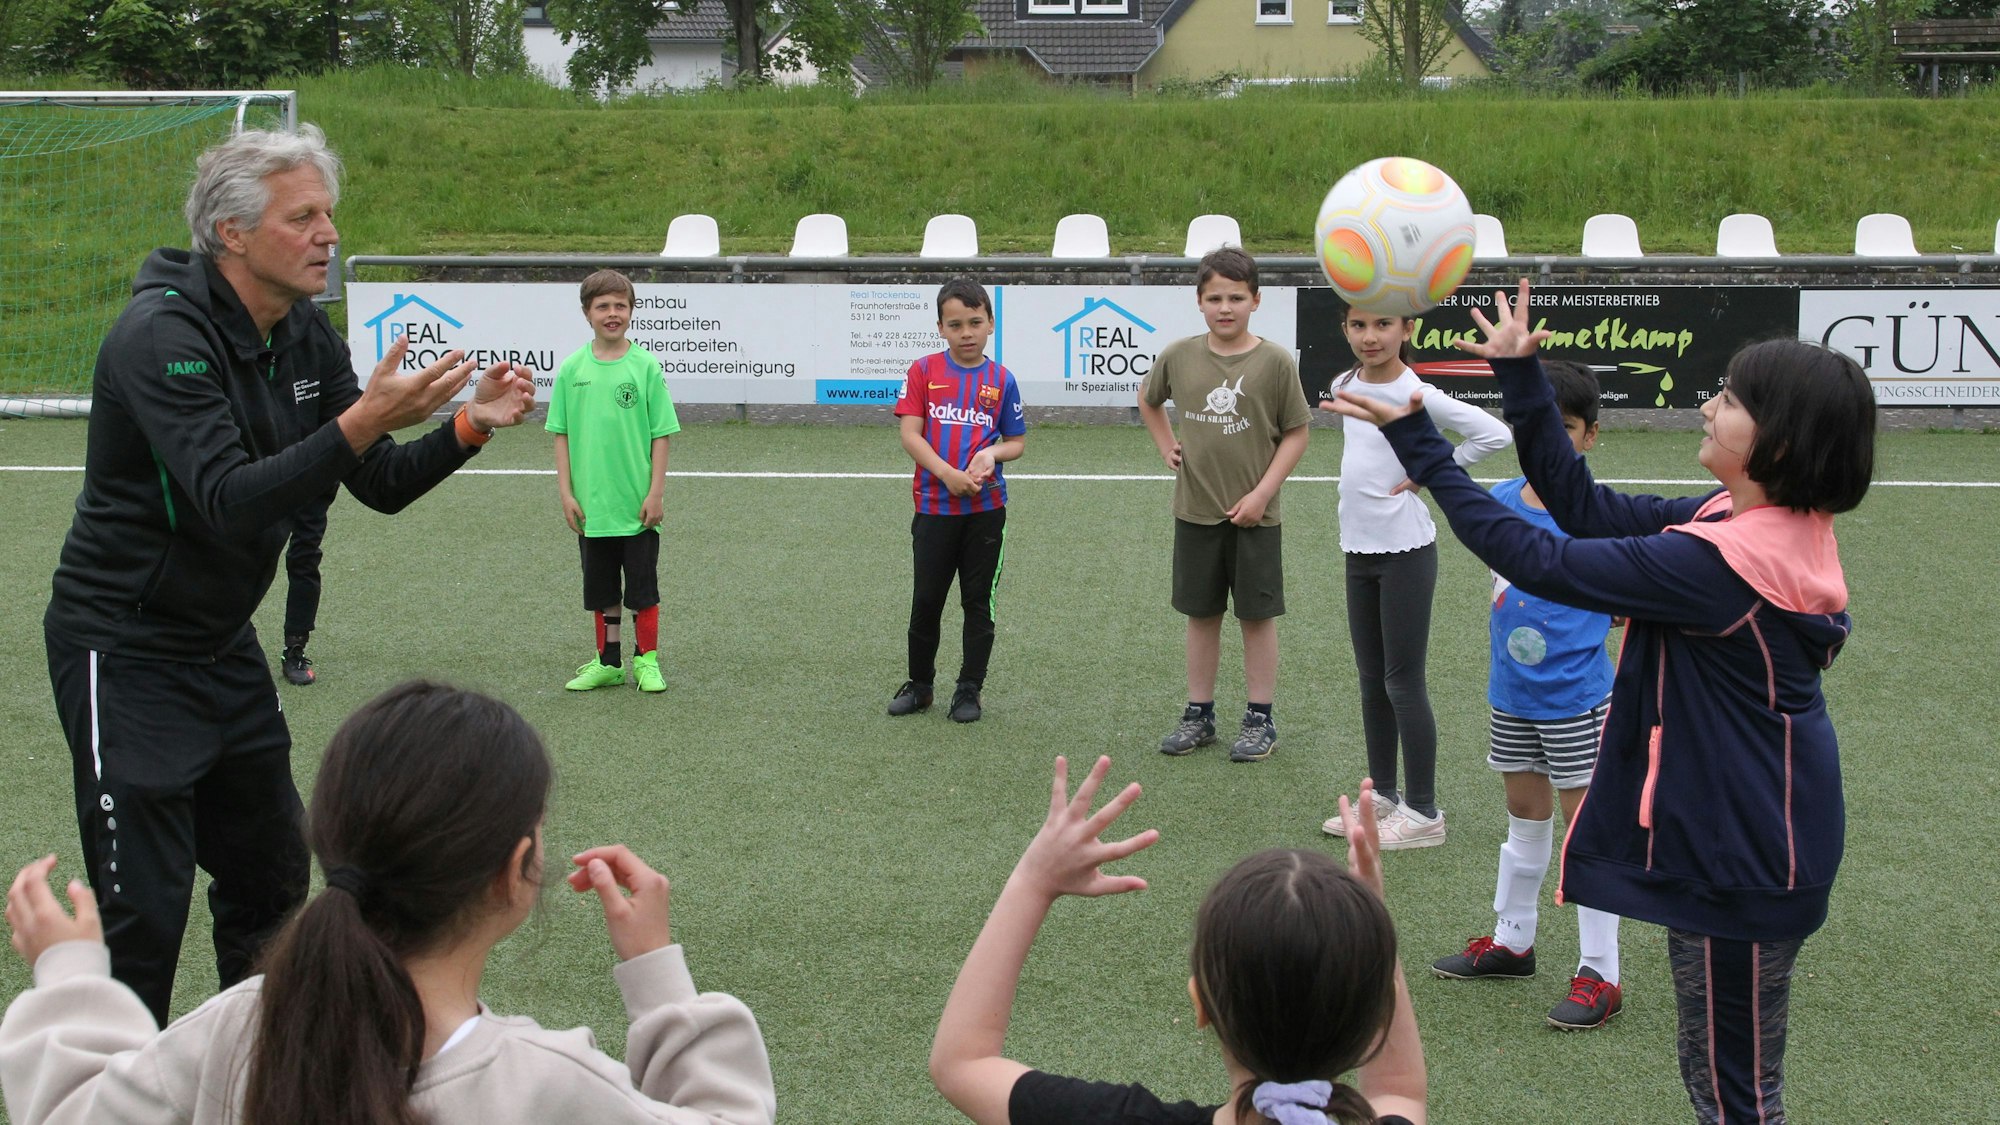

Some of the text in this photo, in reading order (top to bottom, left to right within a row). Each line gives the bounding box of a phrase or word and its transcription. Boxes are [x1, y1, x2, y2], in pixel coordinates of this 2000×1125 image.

[850, 291, 921, 299] Real Trockenbau
[1437, 295, 1458, 306] LER
[1461, 295, 1491, 306] UND
[1561, 294, 1660, 307] MEISTERBETRIEB
[634, 296, 687, 309] enbau
[850, 302, 929, 310] Fraunhoferstraße 8
[850, 313, 901, 321] 53121 Bonn
[630, 317, 721, 331] rissarbeiten
[391, 323, 447, 344] REAL
[929, 332, 941, 340] 93
[1079, 327, 1138, 349] REAL
[1411, 317, 1693, 359] laus hmetkamp
[1821, 301, 2000, 374] GÜN
[850, 340, 945, 348] Mobil +49 163 7969381
[166, 361, 207, 375] JAKO
[850, 357, 914, 366] info-real-reinigun
[1079, 354, 1156, 375] TROC
[659, 359, 795, 378] bäudereinigung
[850, 367, 908, 375] info@real-trock
[826, 388, 900, 398] www.real-t
[1065, 381, 1141, 394] Ihr Spezialist fü
[1872, 386, 2000, 398] UNGSSCHNEIDER
[1455, 390, 1503, 399] Lackierarbeit
[928, 402, 994, 428] Rakuten
[1207, 415, 1234, 424] SHARK
[1222, 416, 1251, 435] attack
[1500, 918, 1521, 931] STA
